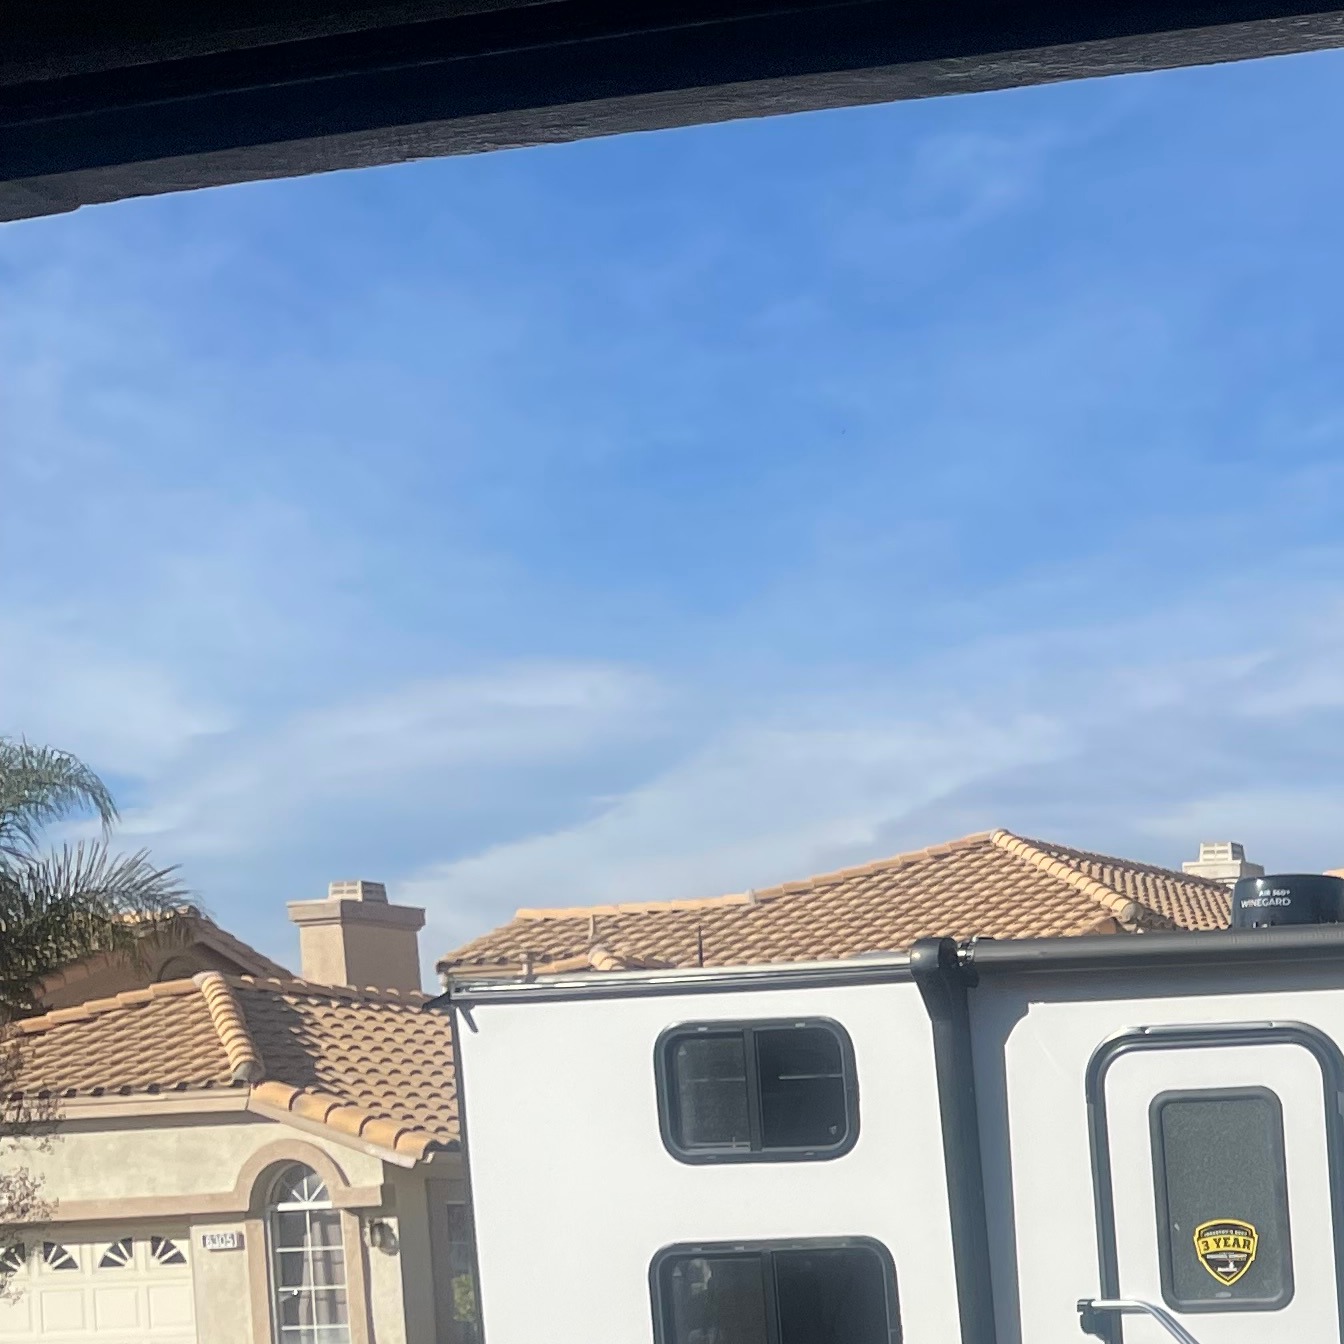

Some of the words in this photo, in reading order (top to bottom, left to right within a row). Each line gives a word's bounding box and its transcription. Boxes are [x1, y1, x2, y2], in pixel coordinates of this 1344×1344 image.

[1241, 898, 1291, 908] WINEGARD
[1202, 1240, 1210, 1251] 3
[1213, 1237, 1251, 1251] YEAR
